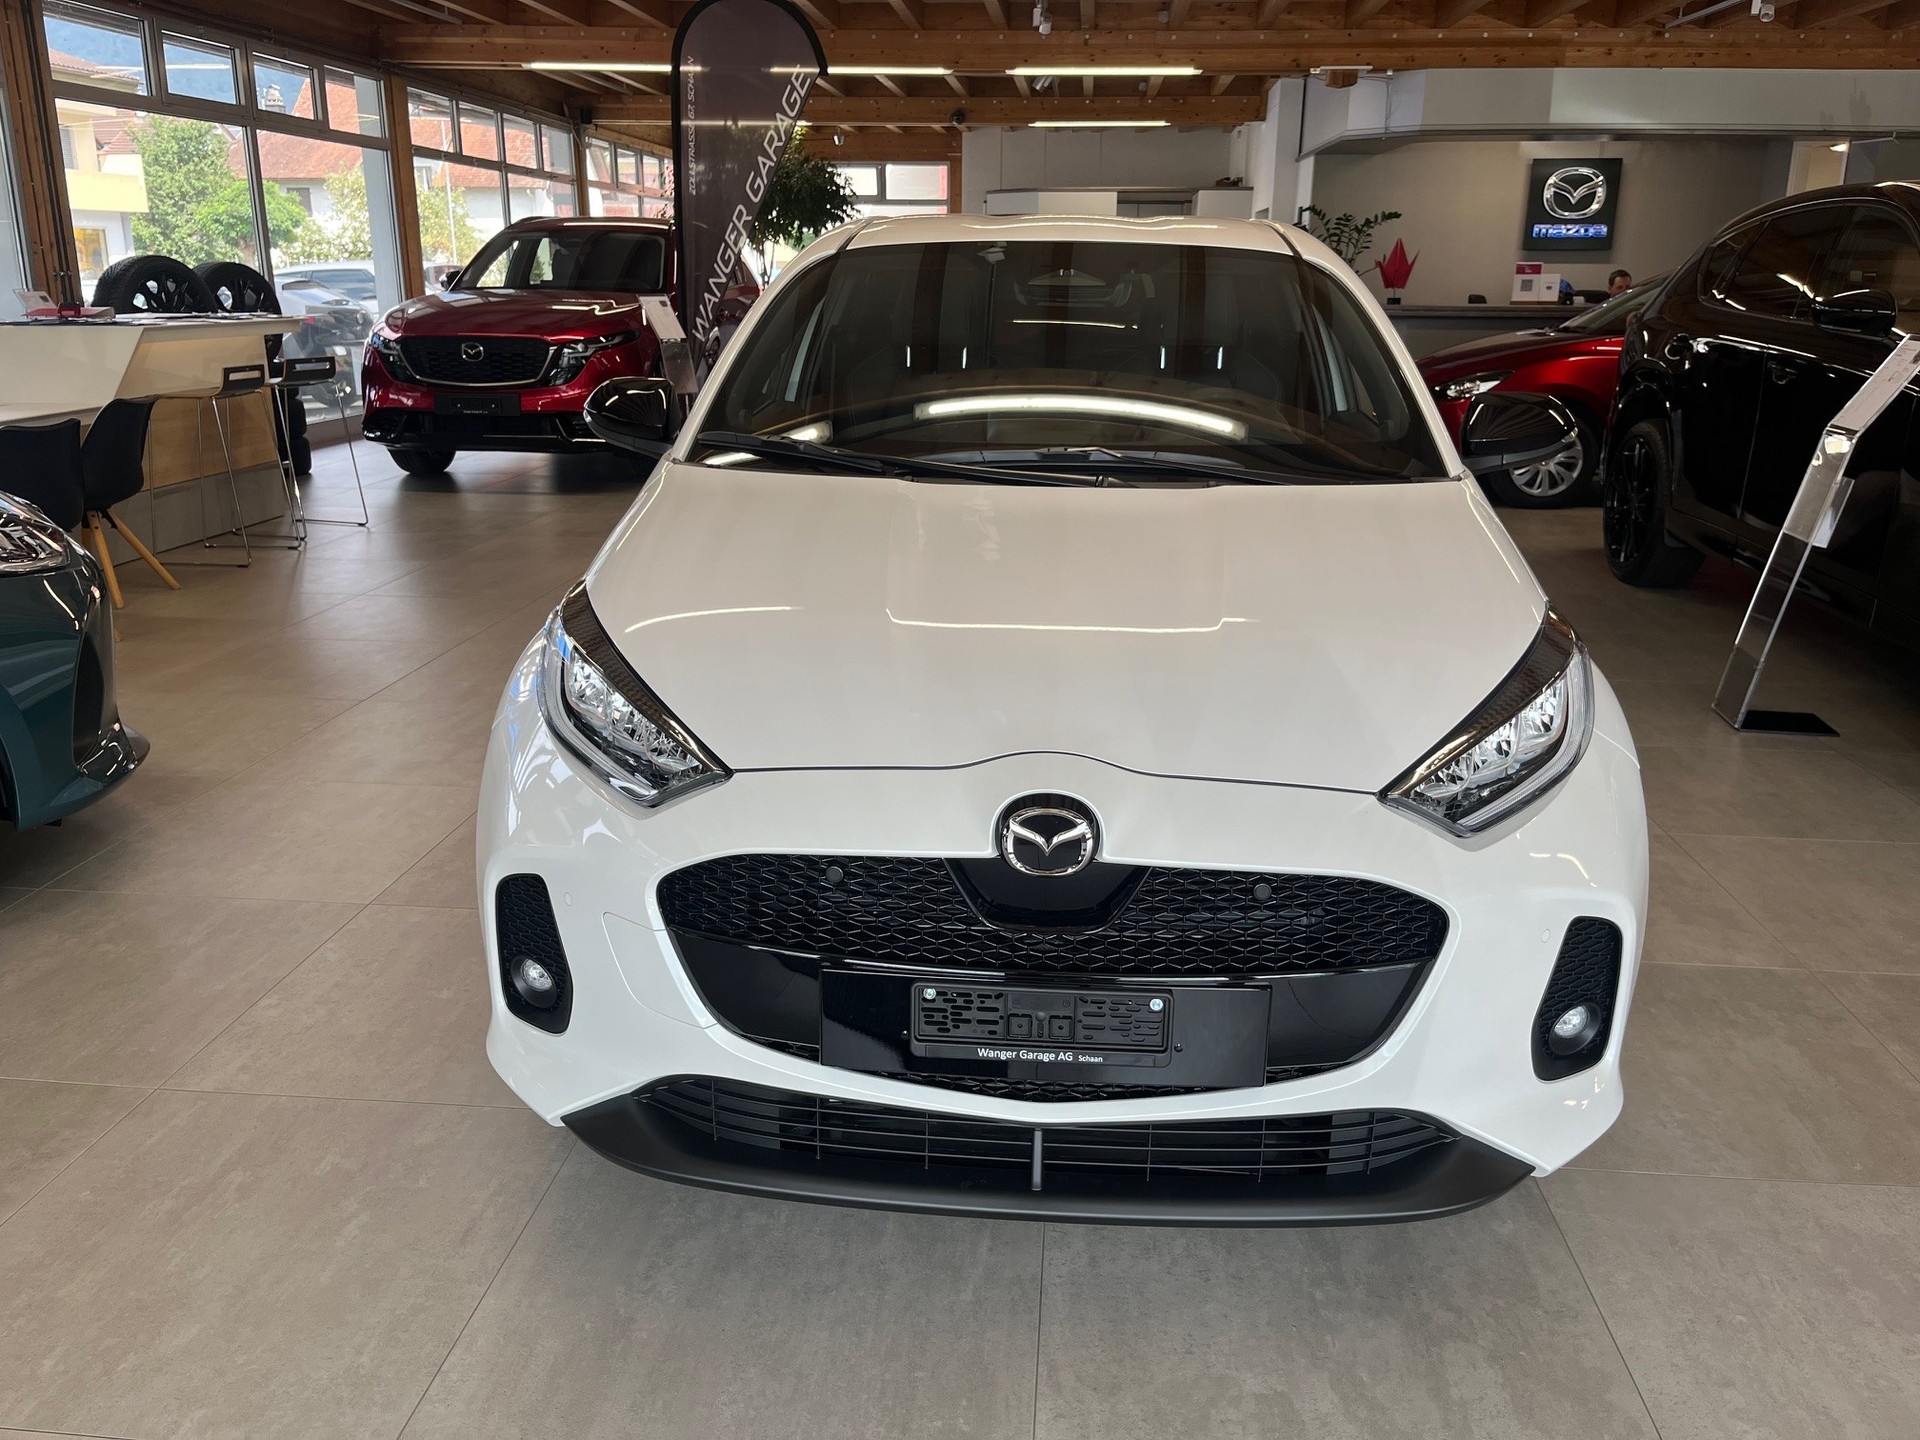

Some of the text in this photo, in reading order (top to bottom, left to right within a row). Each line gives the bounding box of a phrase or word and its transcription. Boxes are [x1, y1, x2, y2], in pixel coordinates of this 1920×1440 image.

[687, 55, 695, 102] SCHAN
[692, 64, 811, 341] WANGER GARAGE
[1532, 224, 1608, 238] mazda
[977, 1047, 1103, 1063] Wanger Garage AG Schaan
